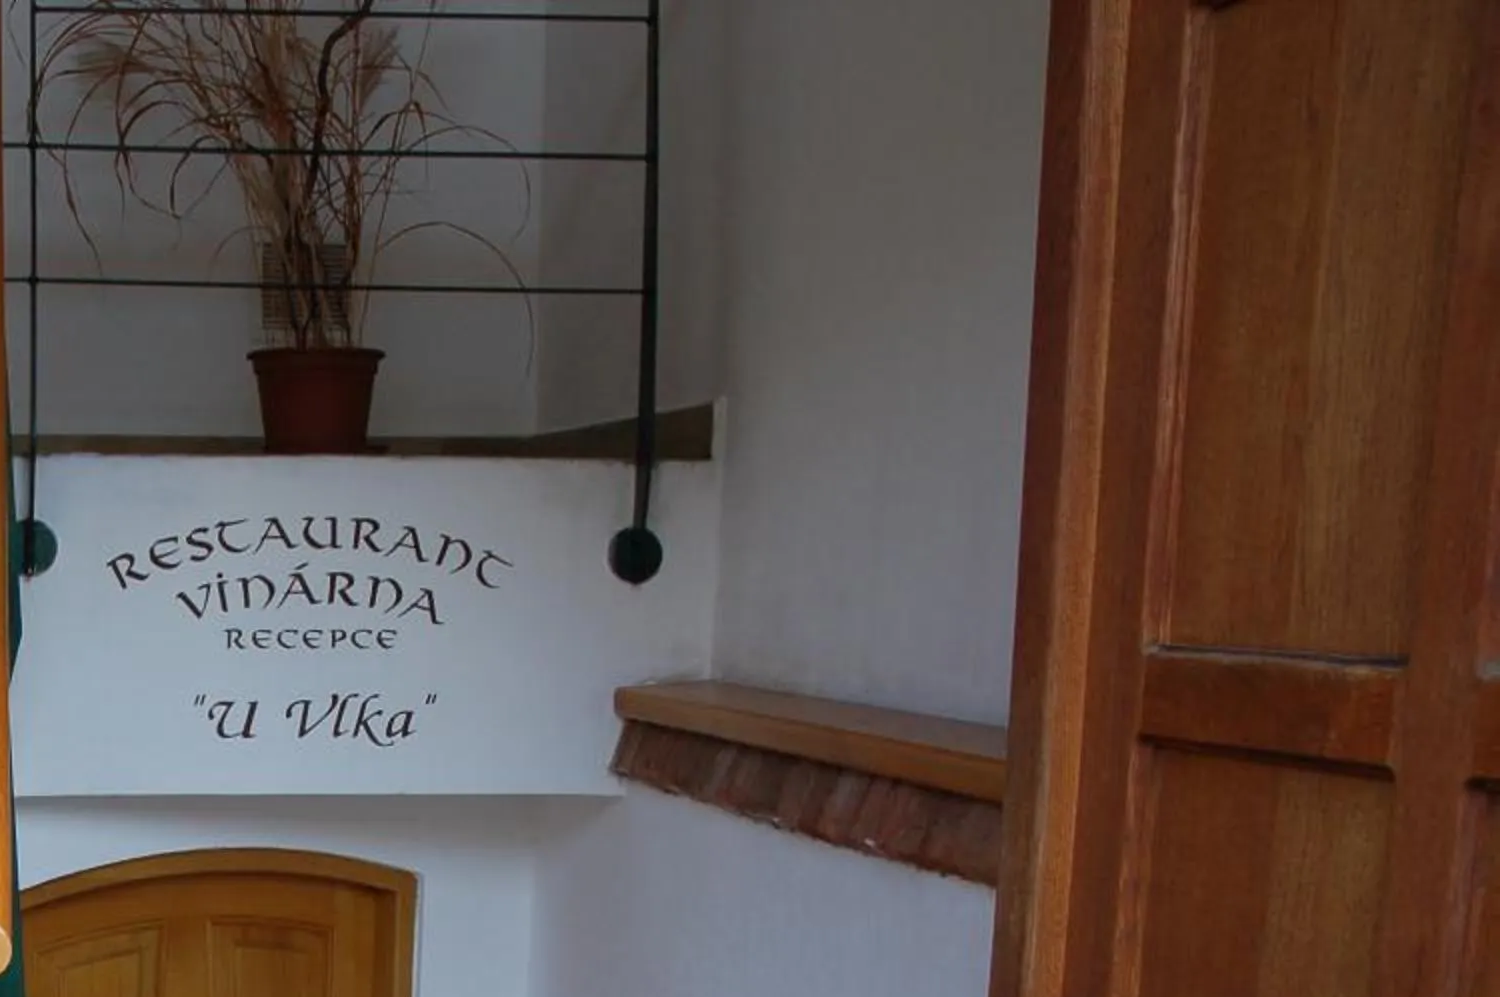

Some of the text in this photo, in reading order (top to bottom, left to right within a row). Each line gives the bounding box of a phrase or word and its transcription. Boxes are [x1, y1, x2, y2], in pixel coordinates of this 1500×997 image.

[106, 515, 514, 590] RESTAURANT
[223, 628, 398, 650] RECEPCE
[193, 692, 438, 748] "U Vlka"
